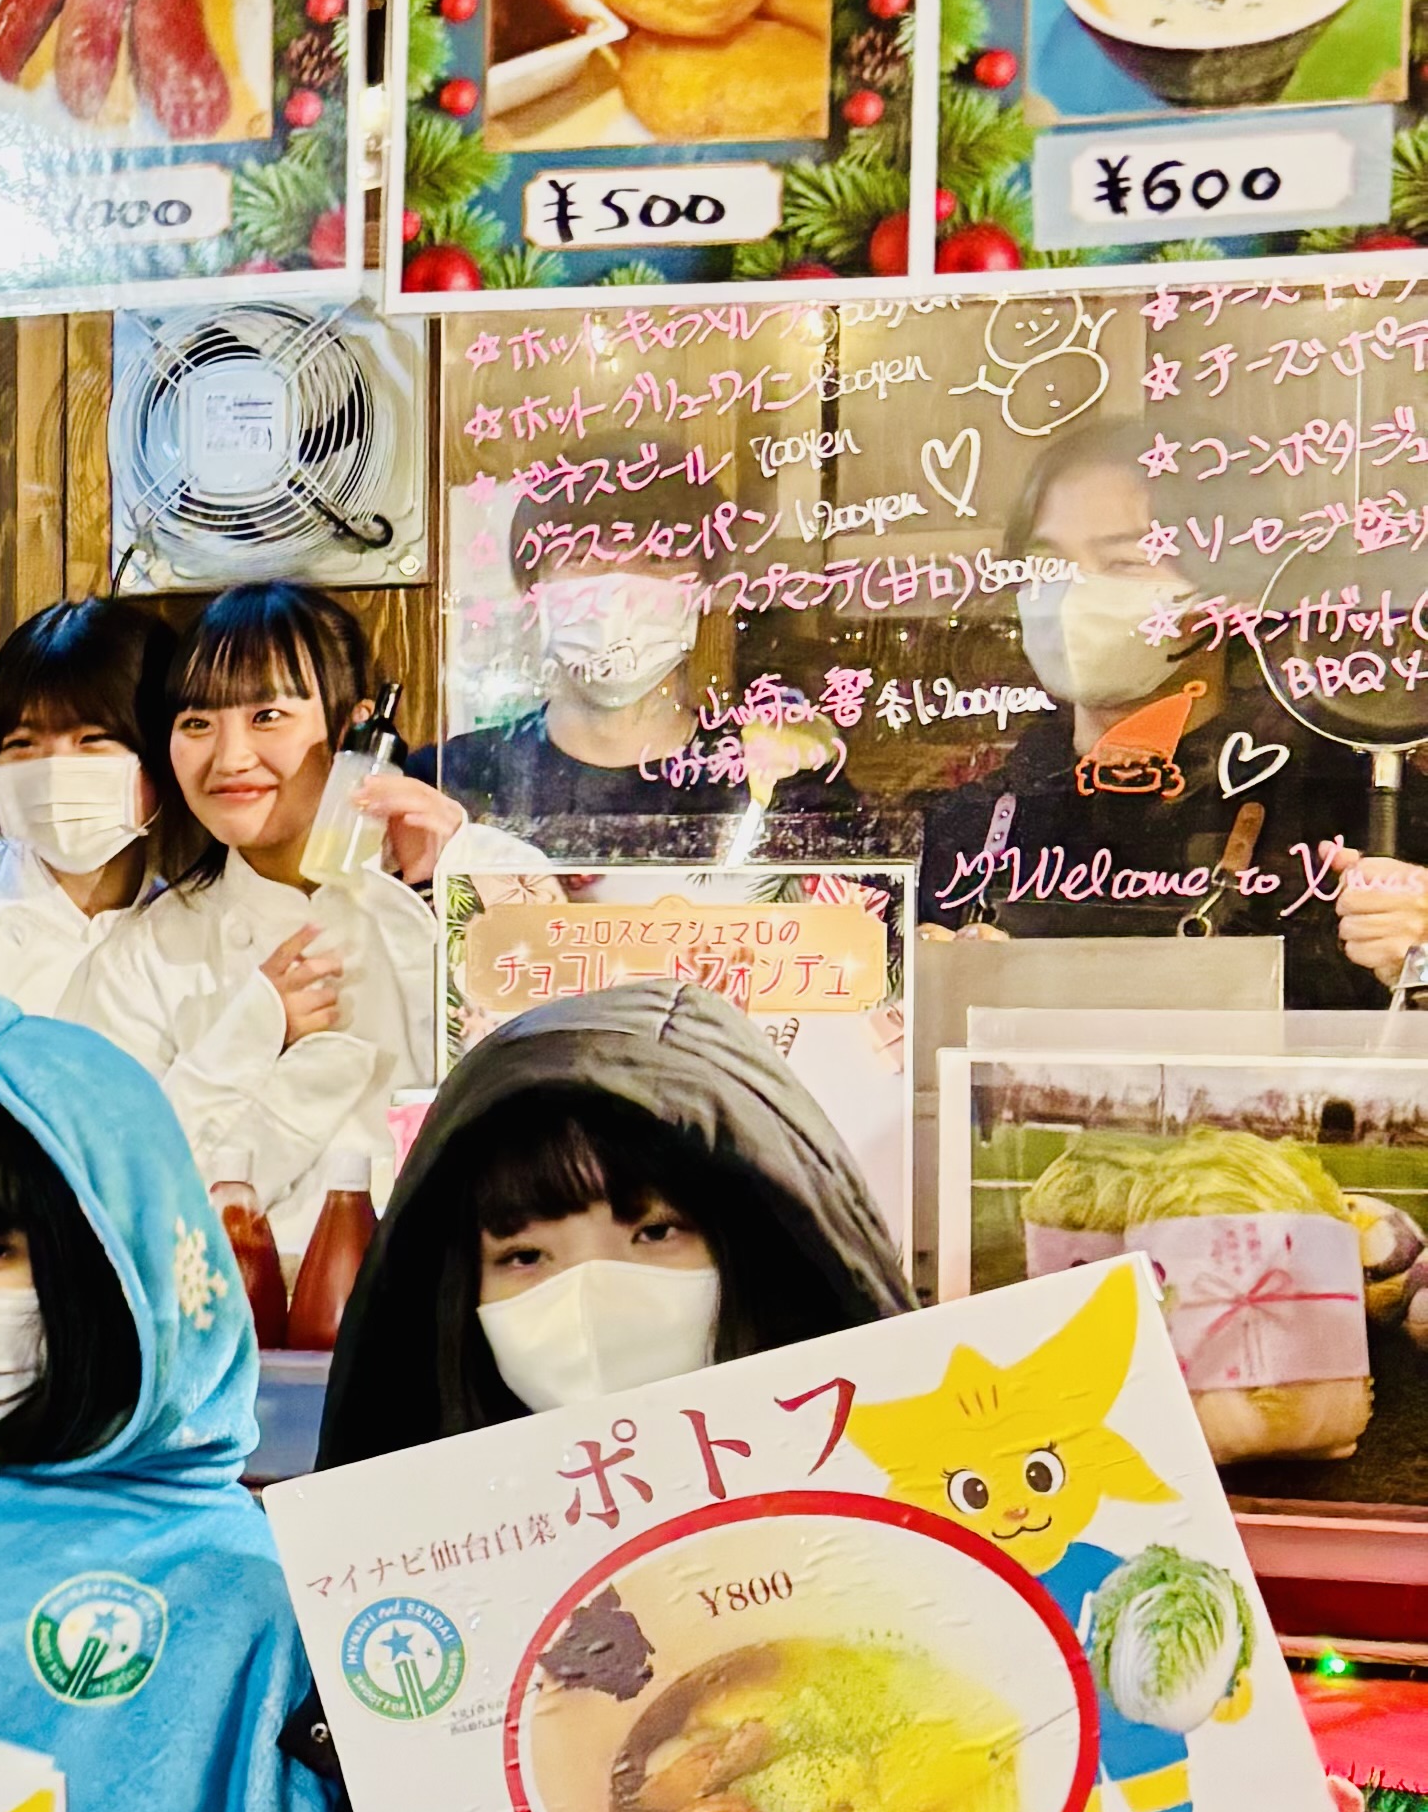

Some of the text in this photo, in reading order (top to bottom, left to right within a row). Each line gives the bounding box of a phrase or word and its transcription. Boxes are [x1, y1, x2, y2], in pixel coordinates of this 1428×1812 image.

[543, 179, 727, 243] ¥500
[1094, 155, 1282, 215] ¥600
[1001, 845, 1210, 903] Welcome
[1235, 866, 1281, 895] to
[546, 918, 801, 947] チュロスとマシュマロの
[493, 952, 852, 1000] チョコレートフォンデュ
[304, 1375, 857, 1599] マイナビ仙台白菜 ポトフ
[695, 1568, 794, 1619] ¥800
[405, 1601, 457, 1643] SENDAI
